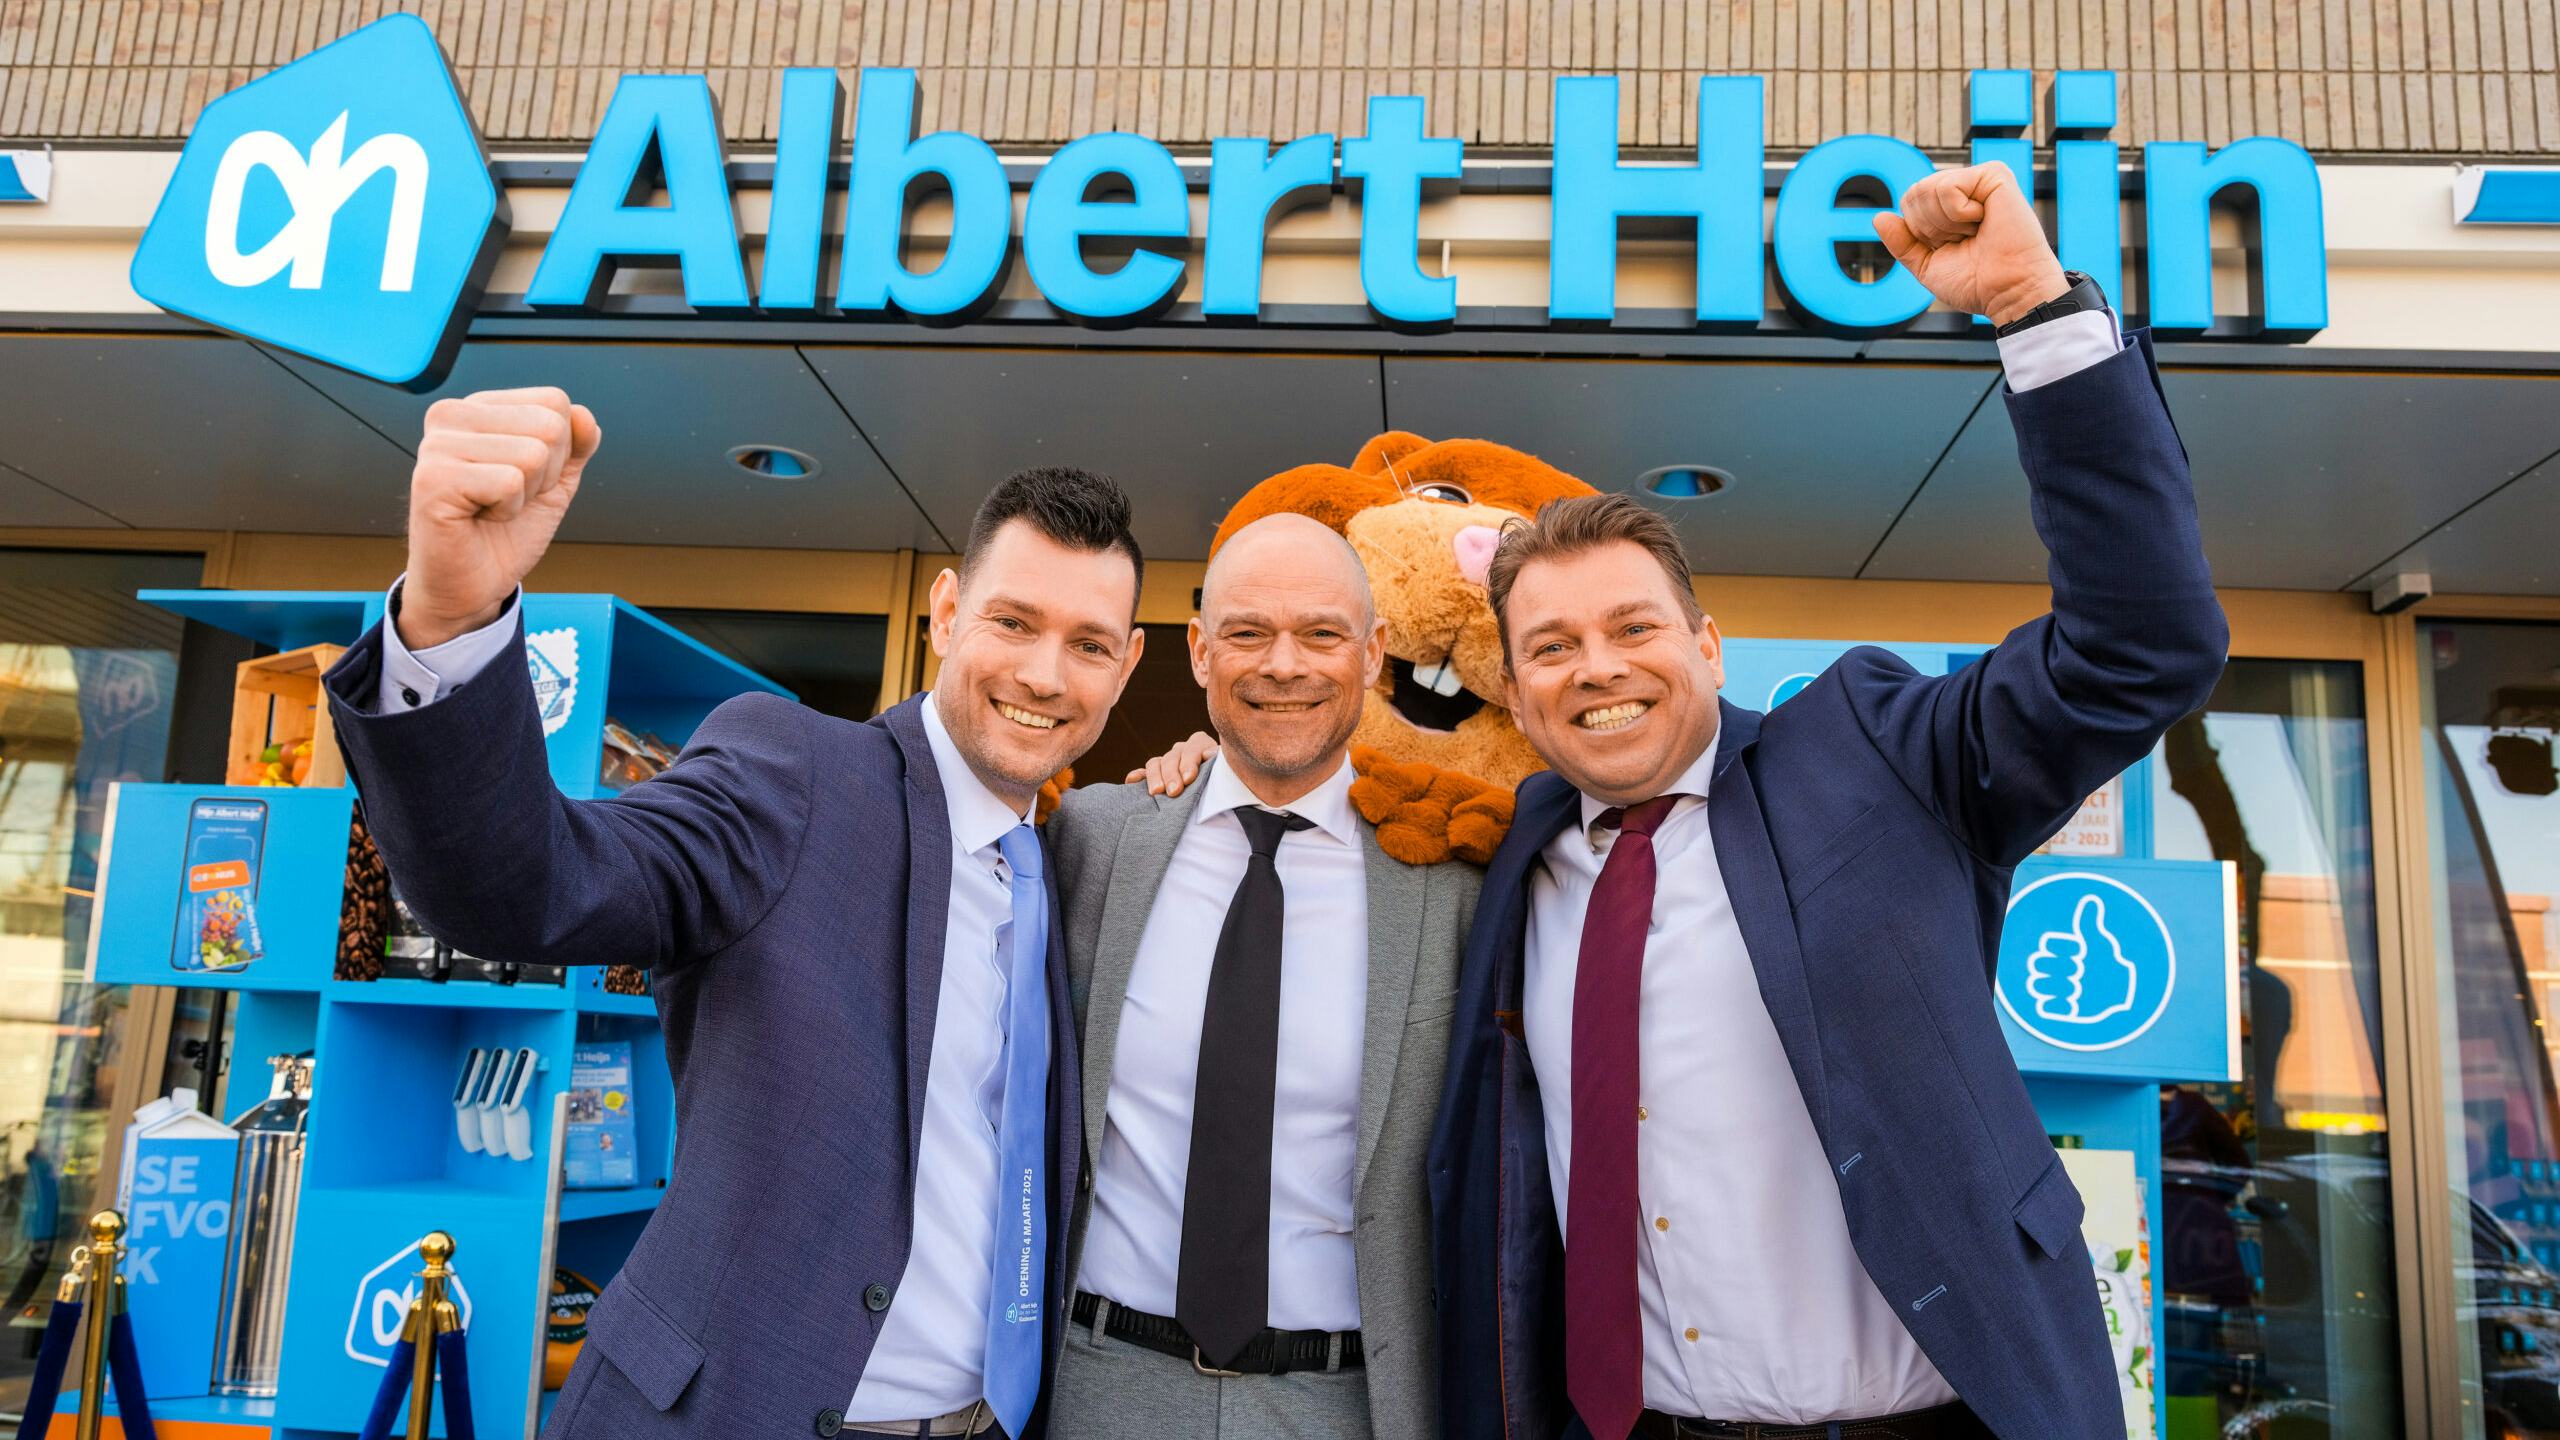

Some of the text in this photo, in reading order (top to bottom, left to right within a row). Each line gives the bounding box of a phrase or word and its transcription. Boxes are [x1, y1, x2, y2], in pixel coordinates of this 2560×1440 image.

[522, 66, 2328, 338] Albert Heijn
[2079, 832, 2109, 846] 2023
[134, 1154, 200, 1195] SE
[1023, 1167, 1033, 1195] 2025
[130, 1200, 231, 1241] FVO
[1022, 1195, 1032, 1236] MAART
[1023, 1237, 1031, 1245] 4
[1019, 1246, 1031, 1297] OPENING
